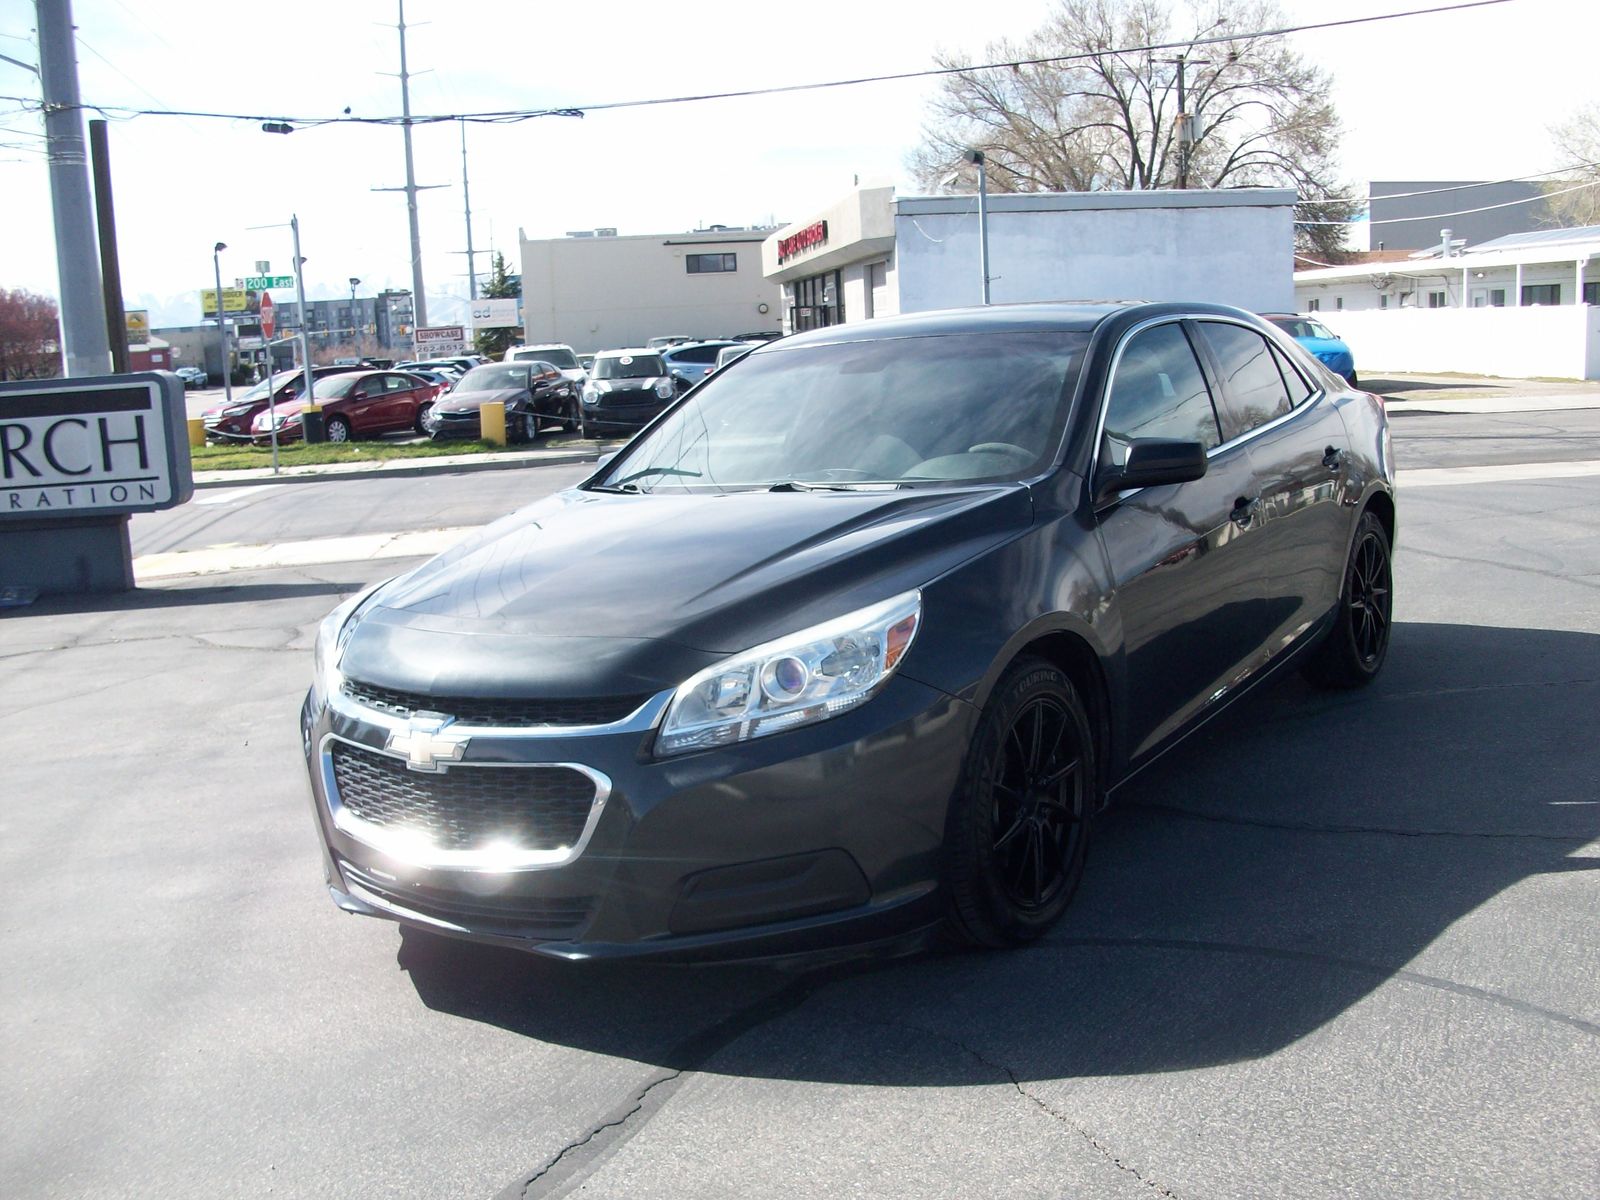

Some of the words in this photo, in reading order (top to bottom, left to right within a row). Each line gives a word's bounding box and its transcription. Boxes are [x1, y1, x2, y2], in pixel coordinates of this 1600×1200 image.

[247, 278, 267, 289] 200
[272, 277, 294, 288] East
[420, 330, 459, 340] SHOWCASE
[417, 344, 465, 353] 262-8512
[1013, 671, 1057, 698] TOURING
